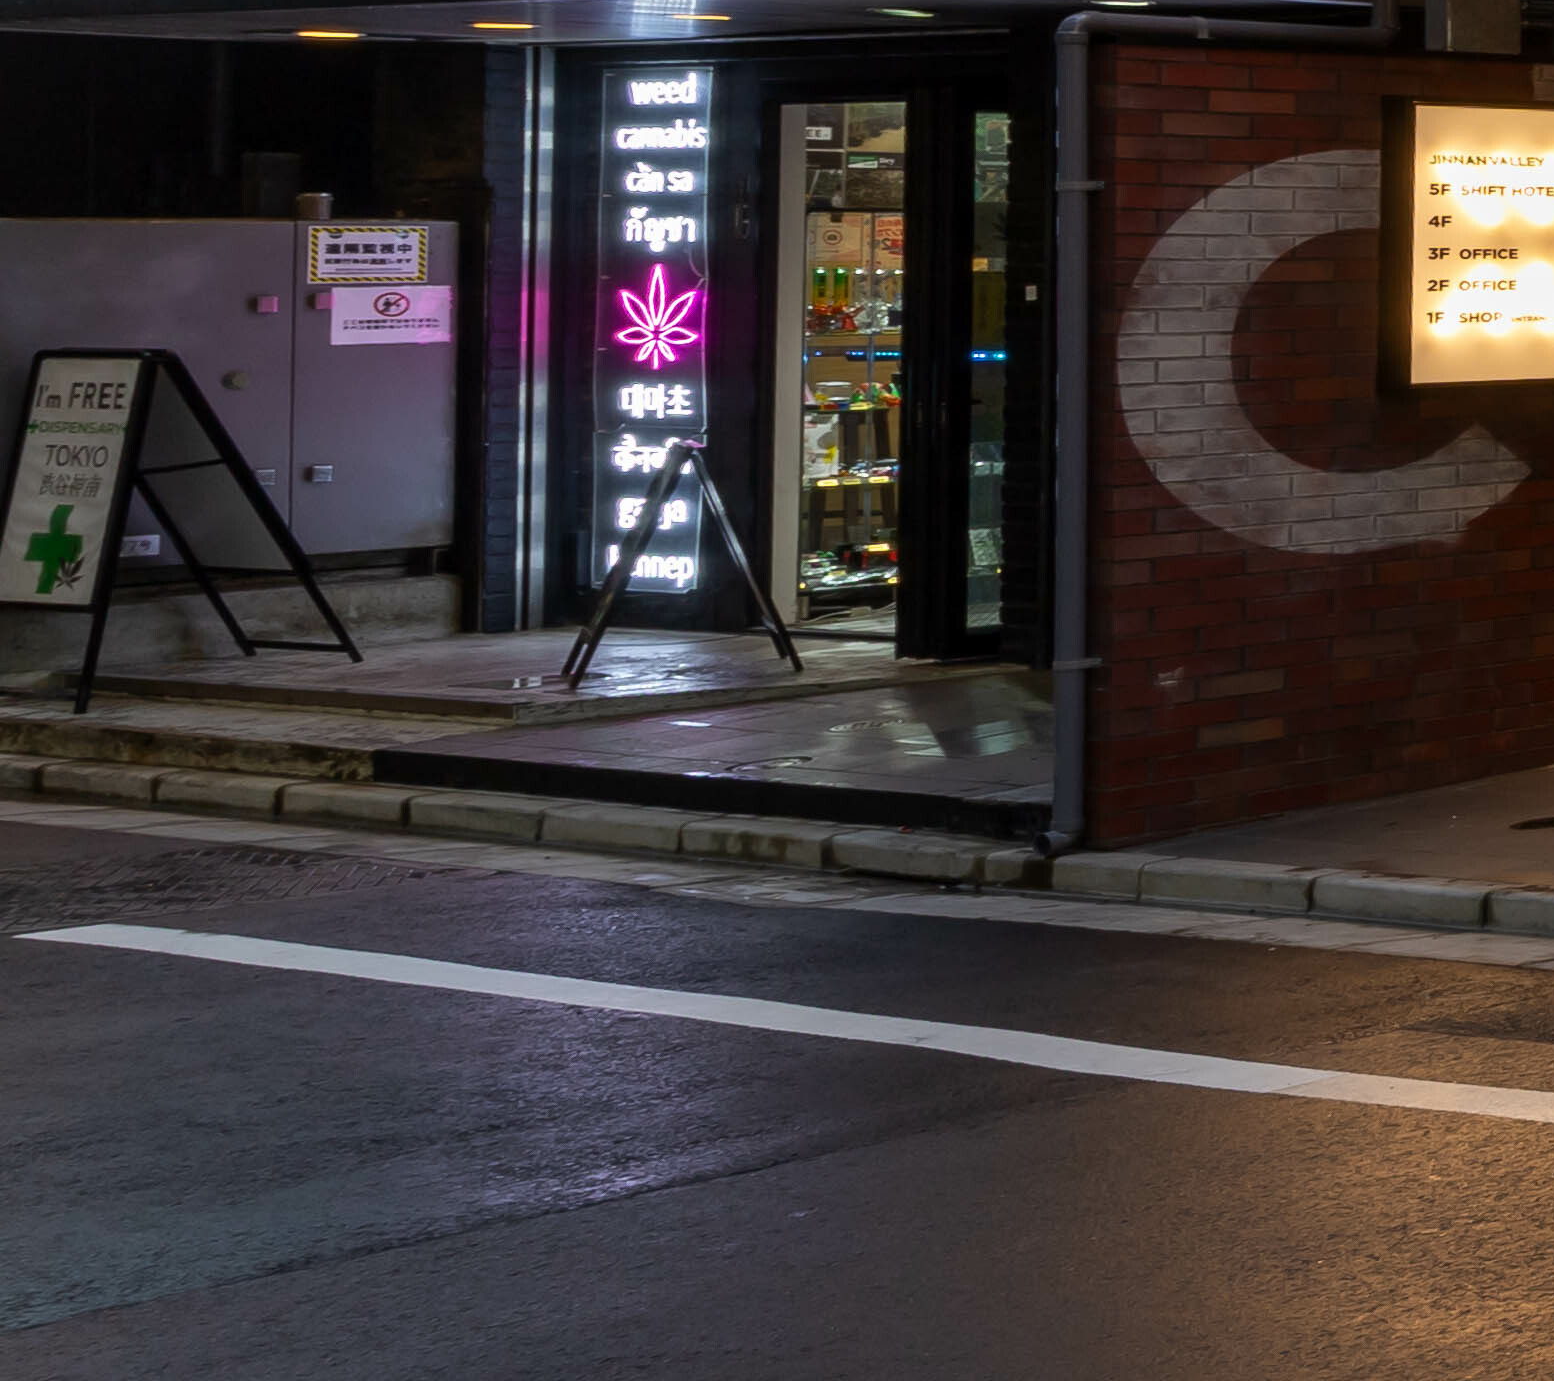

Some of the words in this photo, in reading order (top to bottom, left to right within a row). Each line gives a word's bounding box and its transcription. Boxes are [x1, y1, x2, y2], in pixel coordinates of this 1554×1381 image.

[629, 72, 697, 107] weed
[615, 117, 708, 151] cannabis
[665, 168, 695, 193] sa
[1428, 183, 1453, 197] 5F
[1461, 184, 1508, 198] SHIFT
[1427, 215, 1453, 229] 4F
[1427, 247, 1451, 261] 3F
[1458, 248, 1520, 261] OFFICE
[1426, 279, 1451, 292] 2F
[1458, 279, 1518, 292] OFFICE
[1426, 311, 1445, 325] 1F
[1458, 311, 1503, 324] SHOP
[68, 381, 129, 411] FREE
[38, 420, 122, 436] DISPENSARY
[45, 443, 109, 469] TOKYO
[616, 496, 688, 531] gja
[606, 544, 695, 587] nnep
